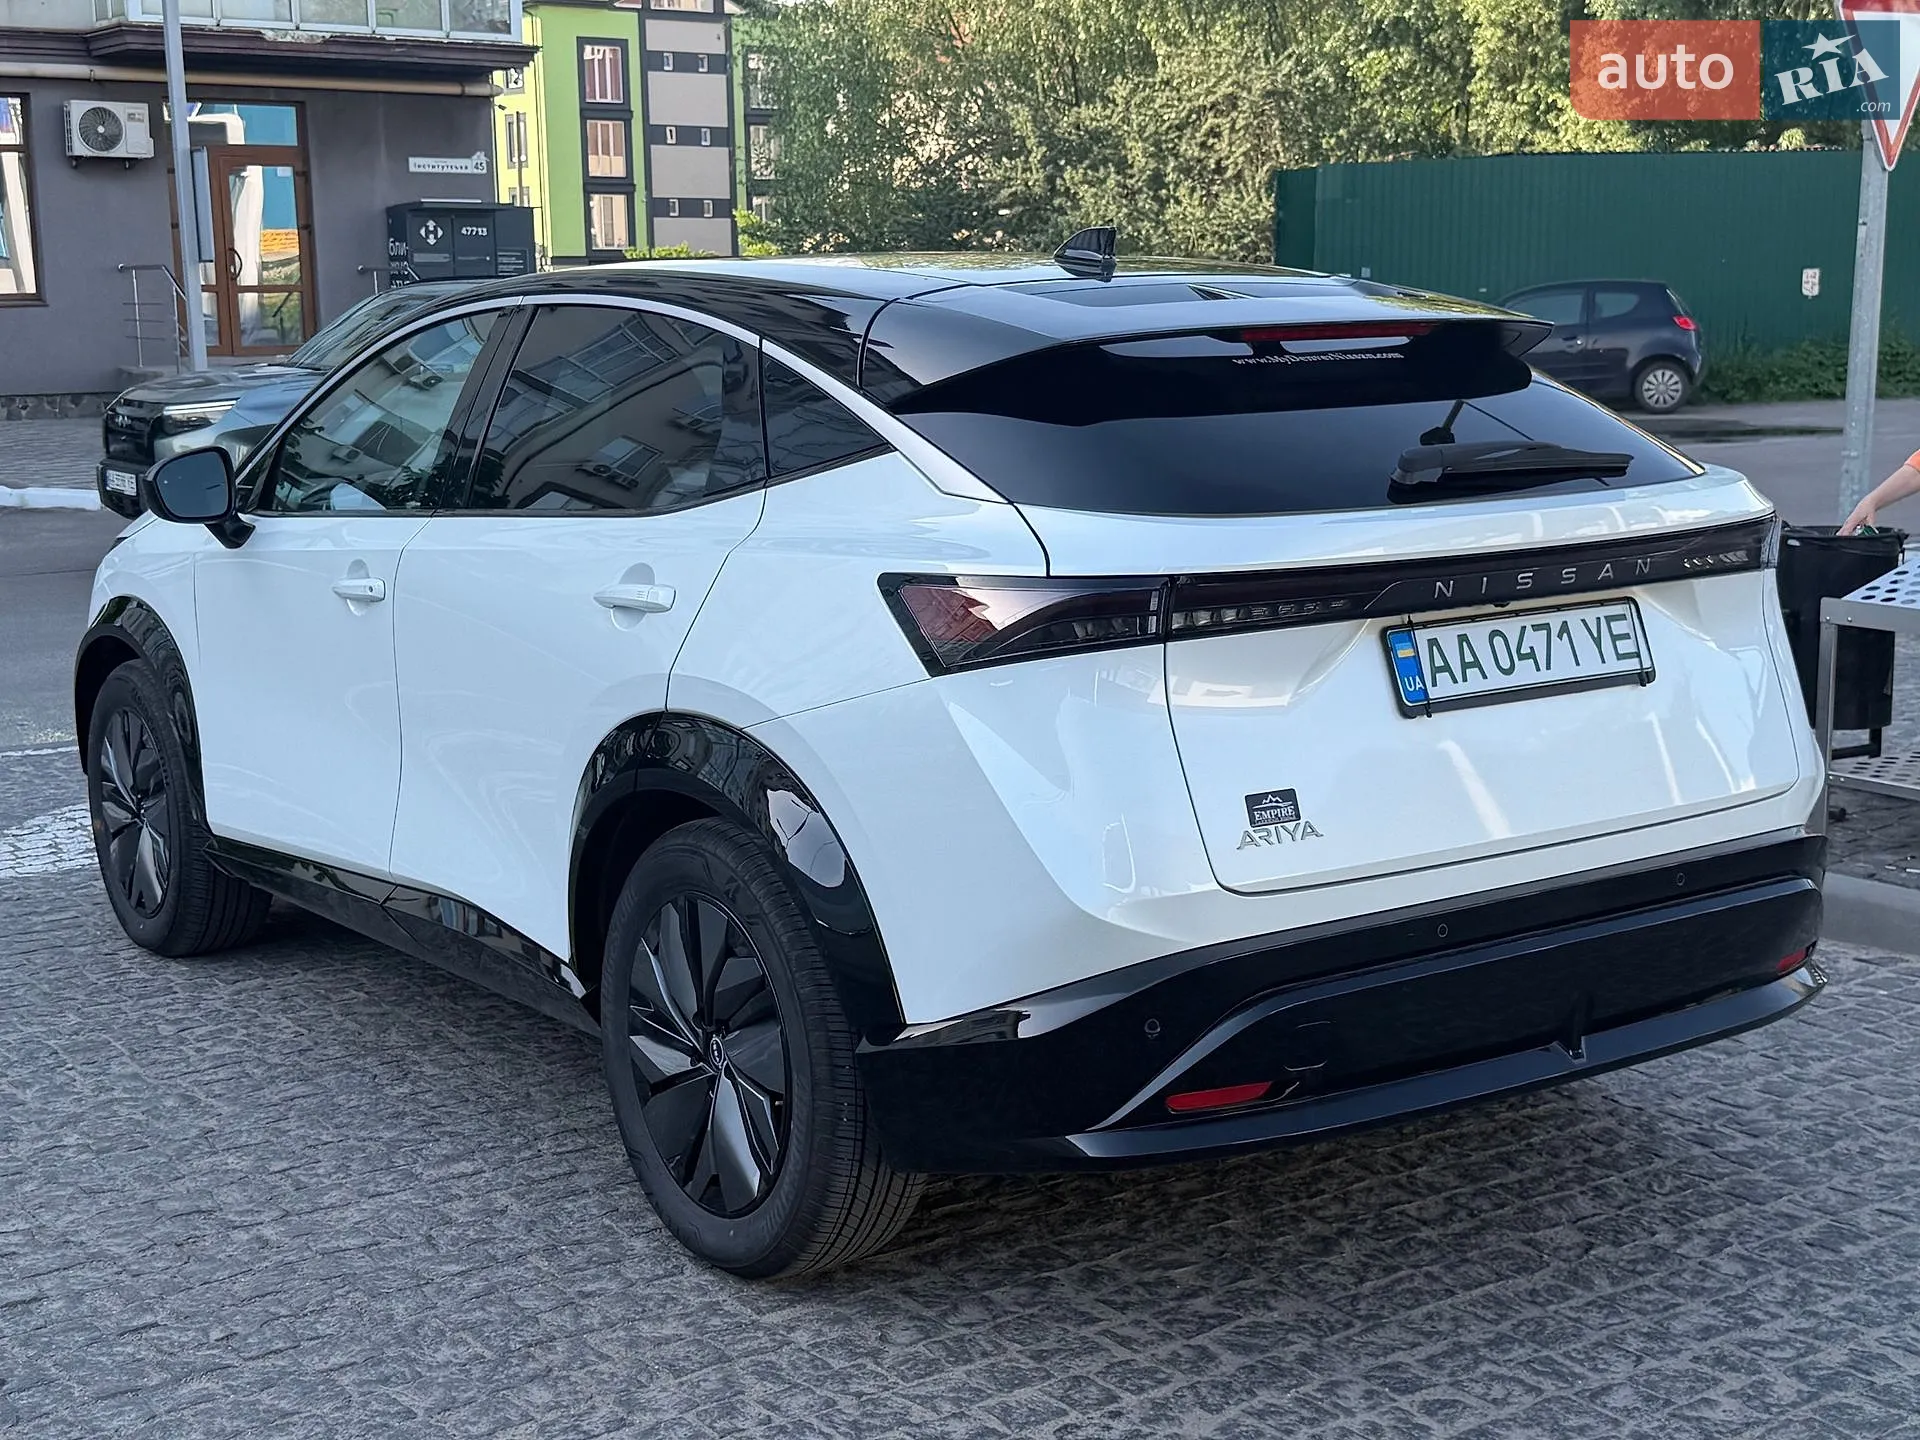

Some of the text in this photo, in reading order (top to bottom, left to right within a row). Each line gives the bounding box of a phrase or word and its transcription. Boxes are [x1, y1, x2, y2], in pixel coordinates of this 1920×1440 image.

[473, 161, 485, 171] 45
[1434, 558, 1651, 599] NISSAN
[1404, 675, 1425, 692] UA
[1253, 805, 1296, 821] EMPIRE
[1236, 820, 1324, 850] ARIYA
